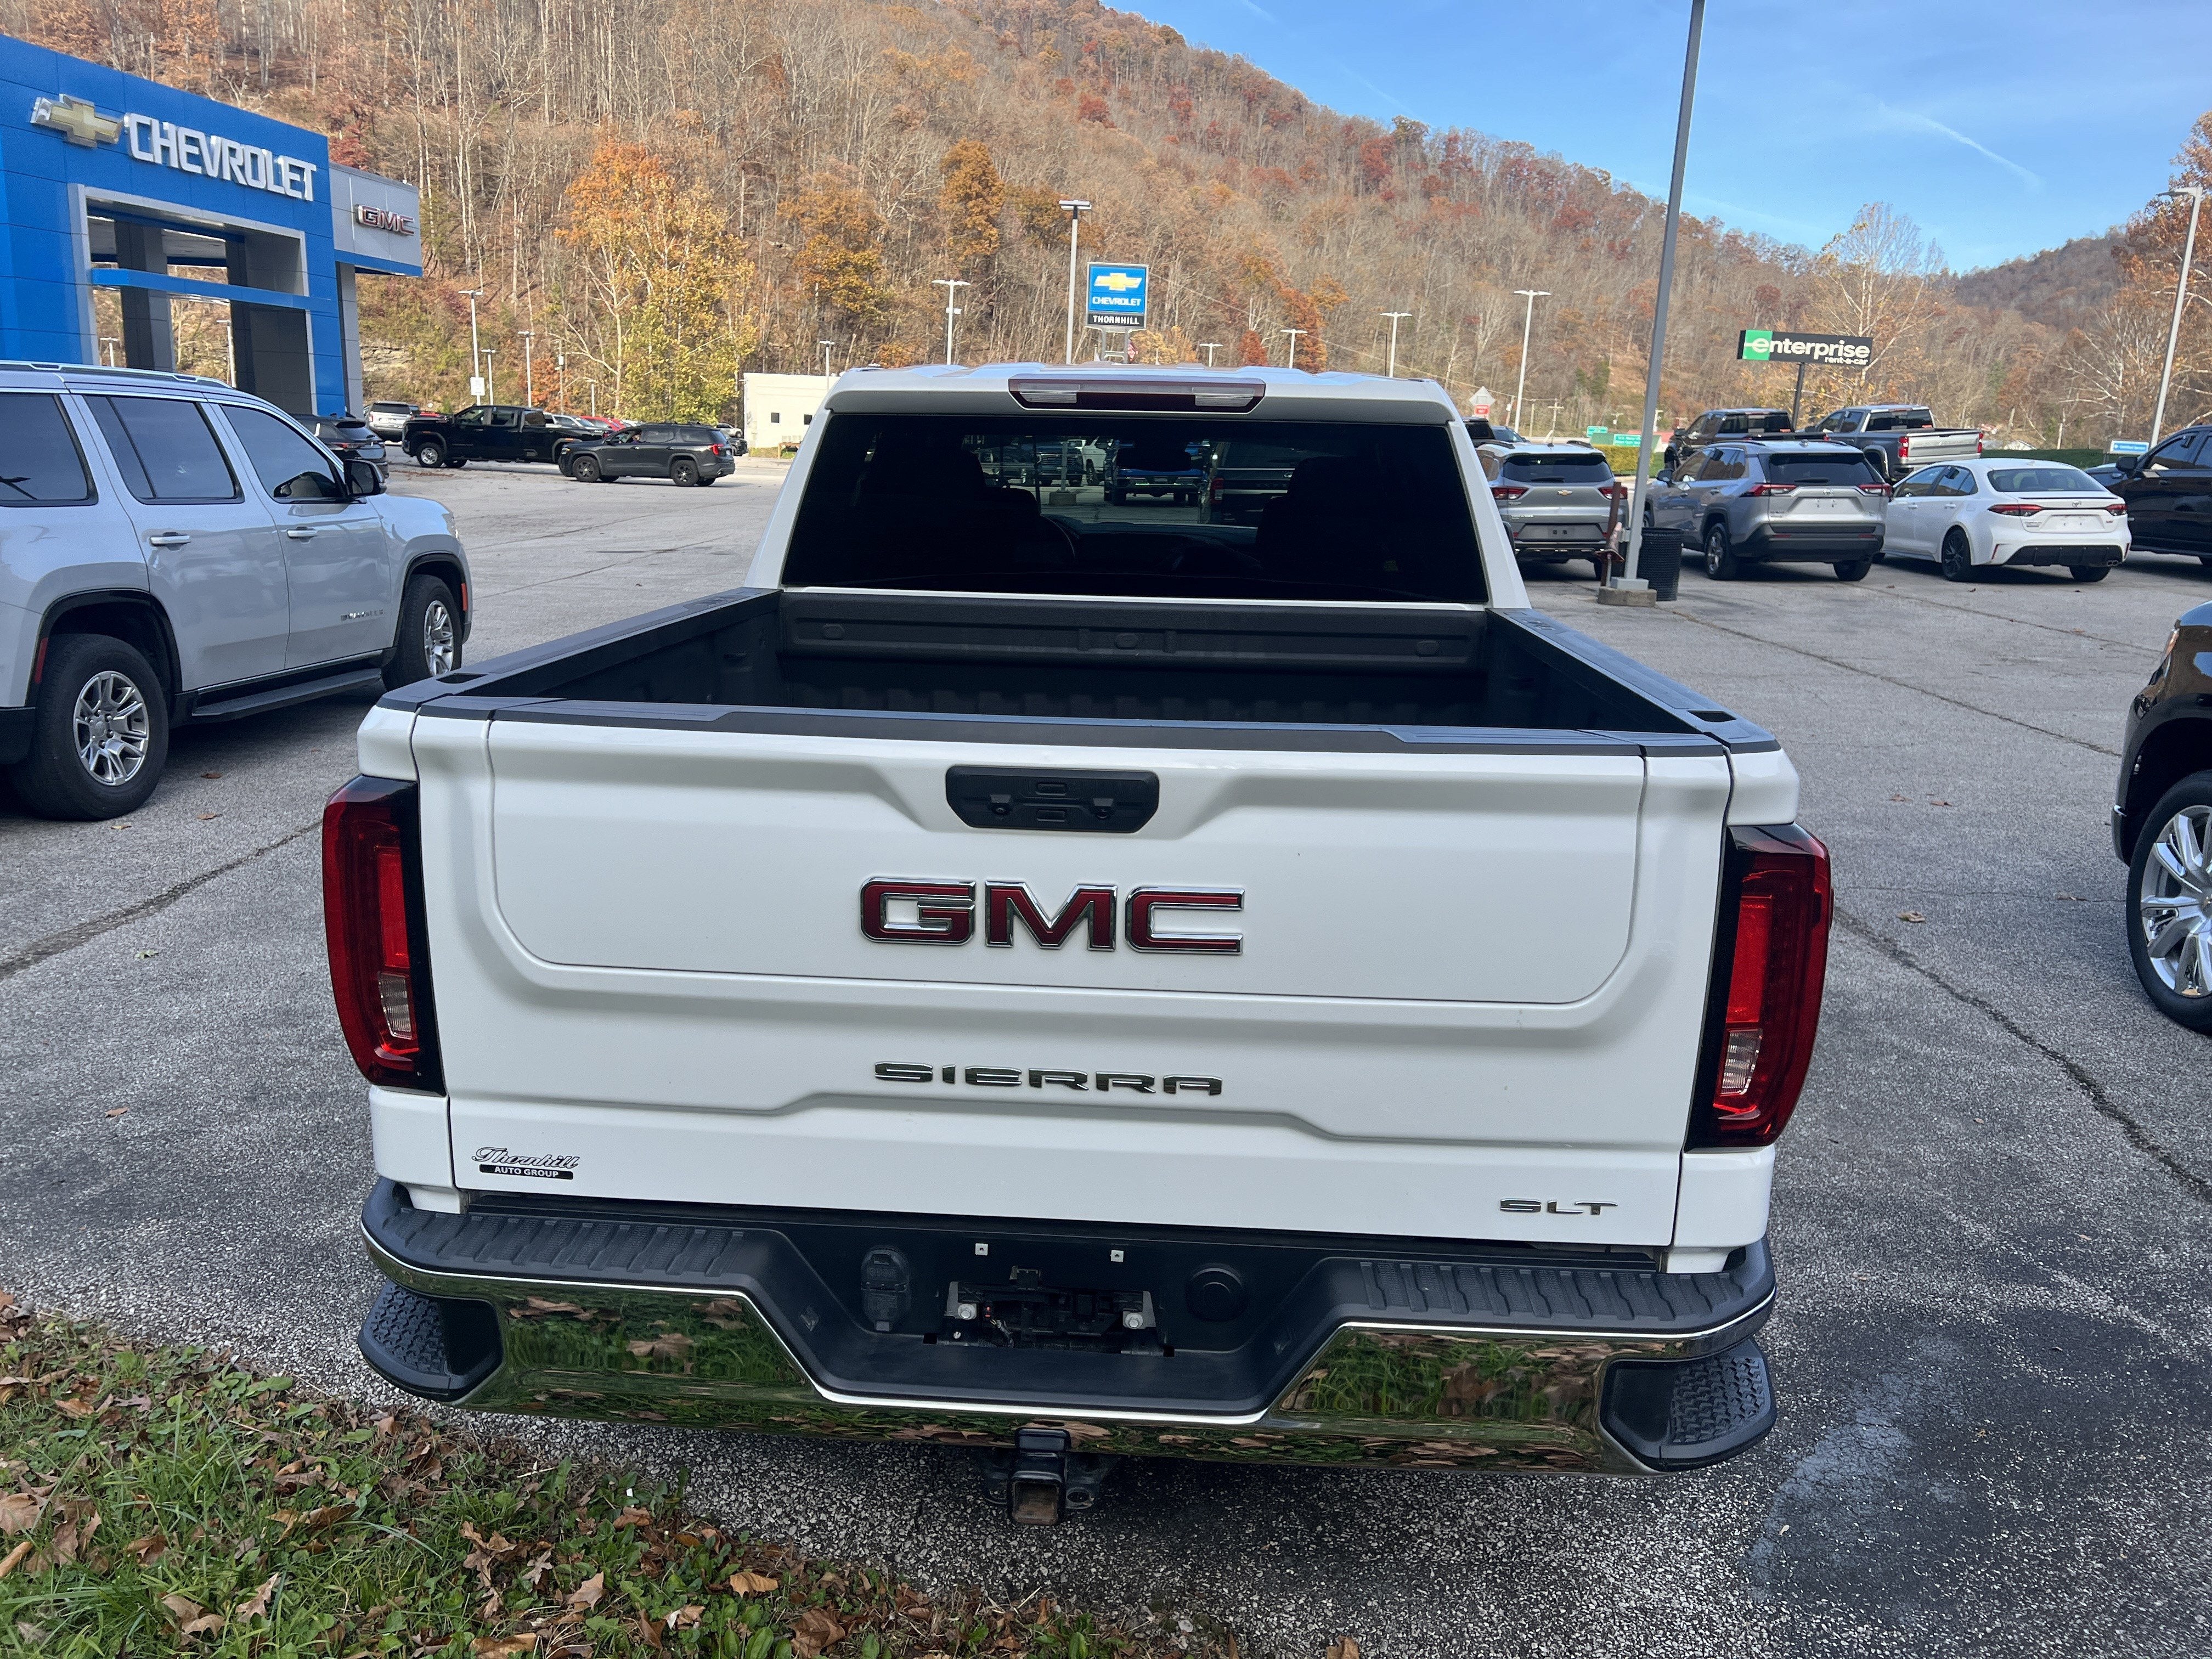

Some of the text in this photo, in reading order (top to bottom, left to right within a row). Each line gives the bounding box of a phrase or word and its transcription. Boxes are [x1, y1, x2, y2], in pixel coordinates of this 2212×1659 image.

[123, 112, 317, 201] CHEVROLET
[357, 205, 415, 236] GMC
[1092, 296, 1142, 306] CHEVROLET
[1092, 315, 1140, 325] THORNHILL
[1745, 337, 1870, 360] enterprise
[1824, 356, 1869, 365] rent-a-car
[860, 876, 1245, 955] GMC
[874, 1060, 1223, 1095] SIERRA
[471, 1147, 580, 1169] Thornhill
[494, 1166, 559, 1178] AUTO GROUP
[1500, 1198, 1618, 1215] SLT
